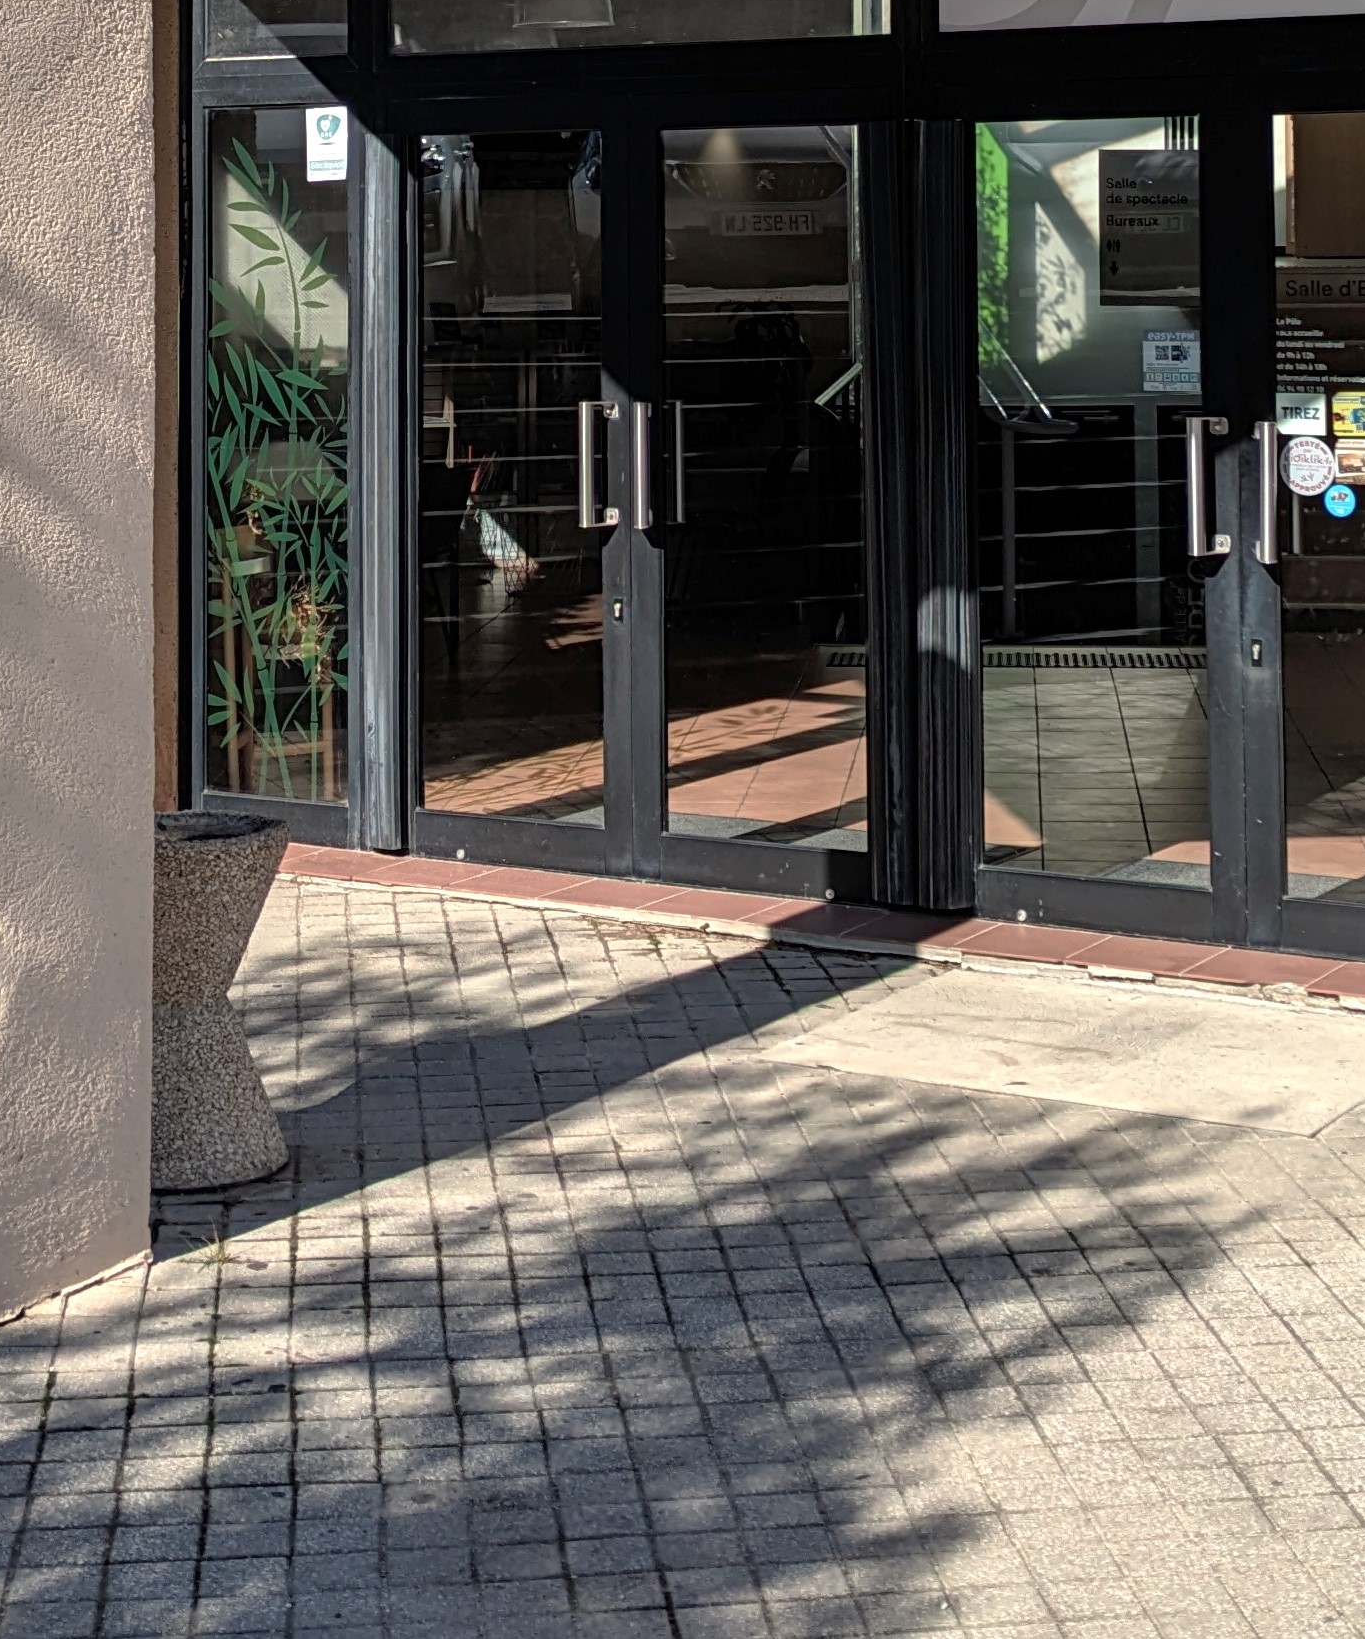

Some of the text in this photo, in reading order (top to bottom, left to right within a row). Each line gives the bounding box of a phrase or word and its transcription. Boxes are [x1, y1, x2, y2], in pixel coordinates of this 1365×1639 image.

[1106, 178, 1137, 188] Salle
[1106, 194, 1188, 206] de spectacle
[1106, 215, 1159, 226] Bureaux
[1285, 280, 1332, 297] Salle
[1281, 407, 1320, 420] TIREZ
